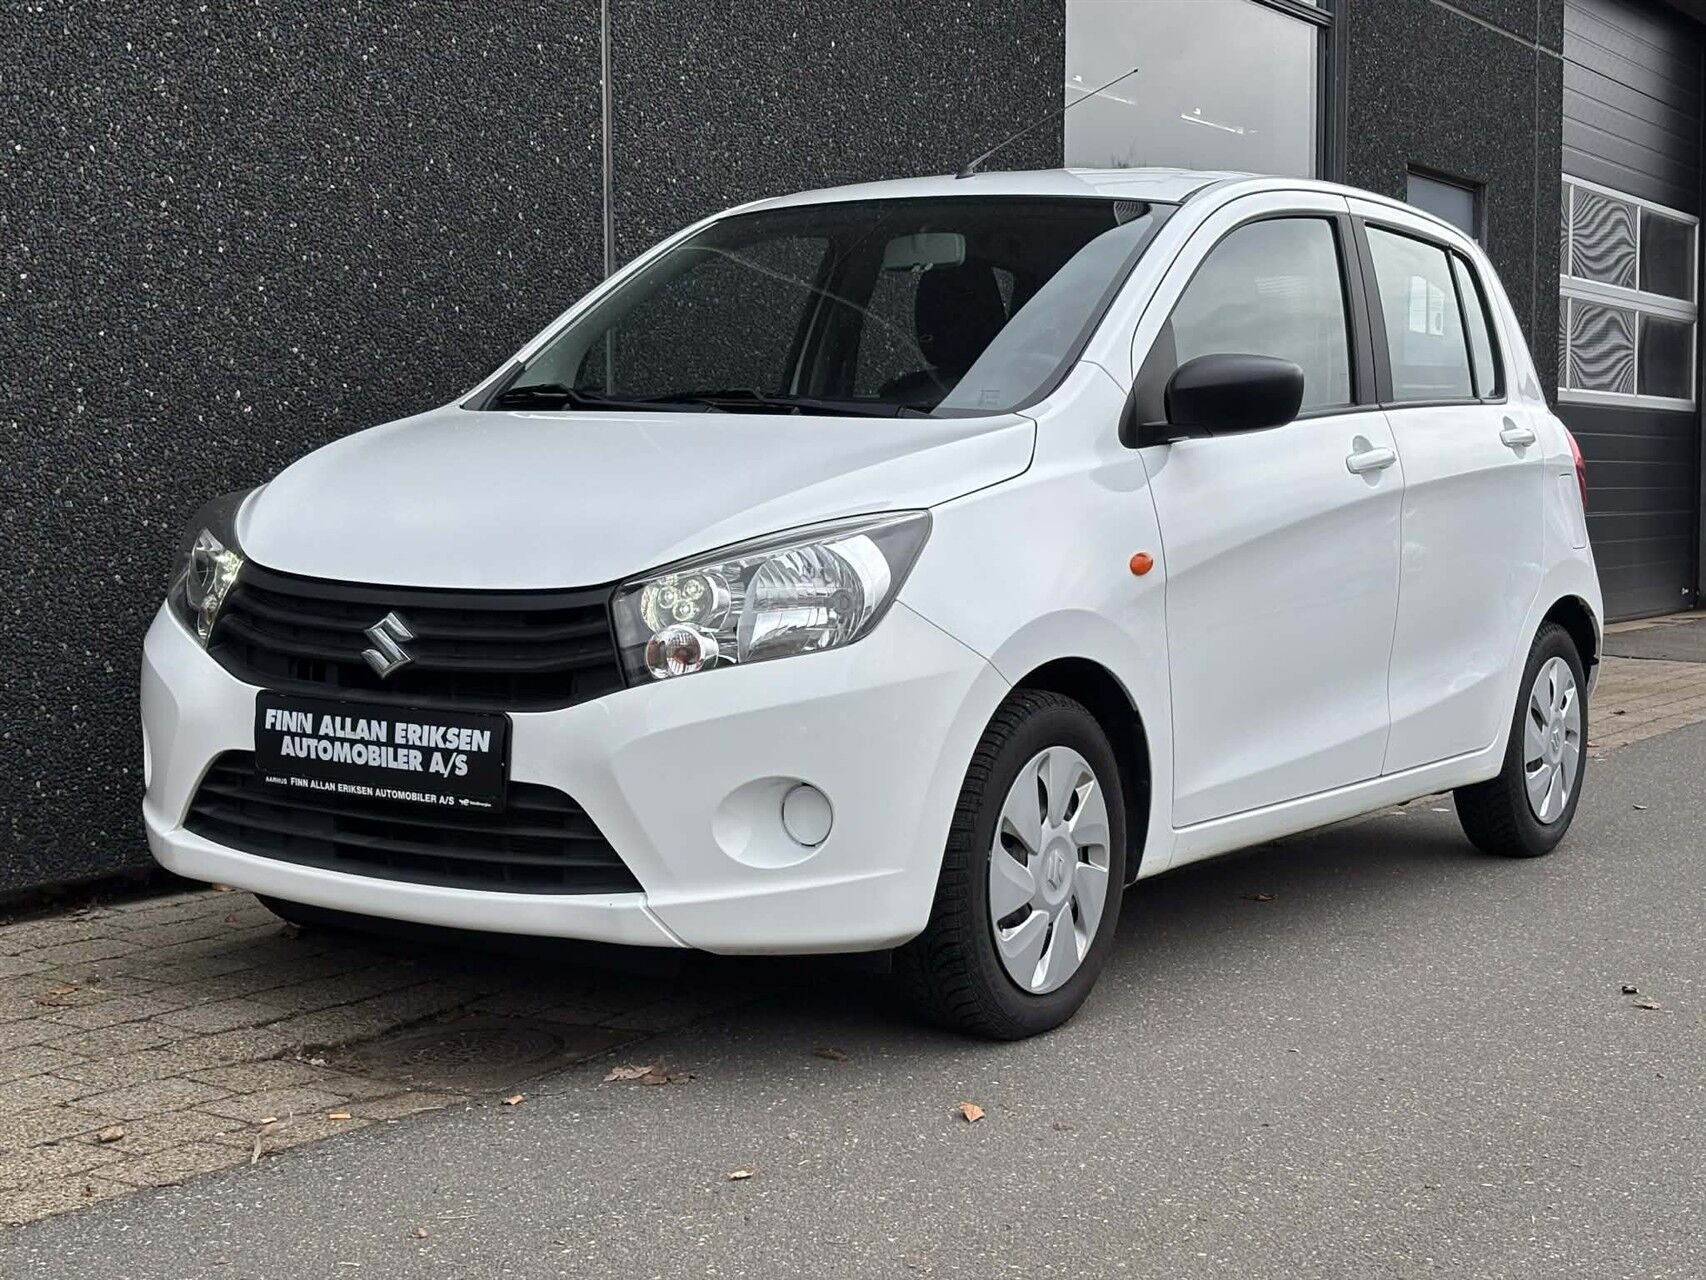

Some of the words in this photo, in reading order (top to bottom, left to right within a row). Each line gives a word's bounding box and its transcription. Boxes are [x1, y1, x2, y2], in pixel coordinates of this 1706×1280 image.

[265, 709, 313, 734] FINN
[319, 715, 387, 742] ALLAN
[394, 722, 491, 752] ERIKSEN
[281, 736, 423, 772] AUTOMOBILER
[429, 752, 468, 778] A/S
[290, 777, 309, 788] FINN
[310, 779, 336, 792] ALLAN
[338, 783, 373, 796] ERIKSEN
[375, 787, 437, 803] AUTOMOBILER
[439, 795, 455, 805] A/S
